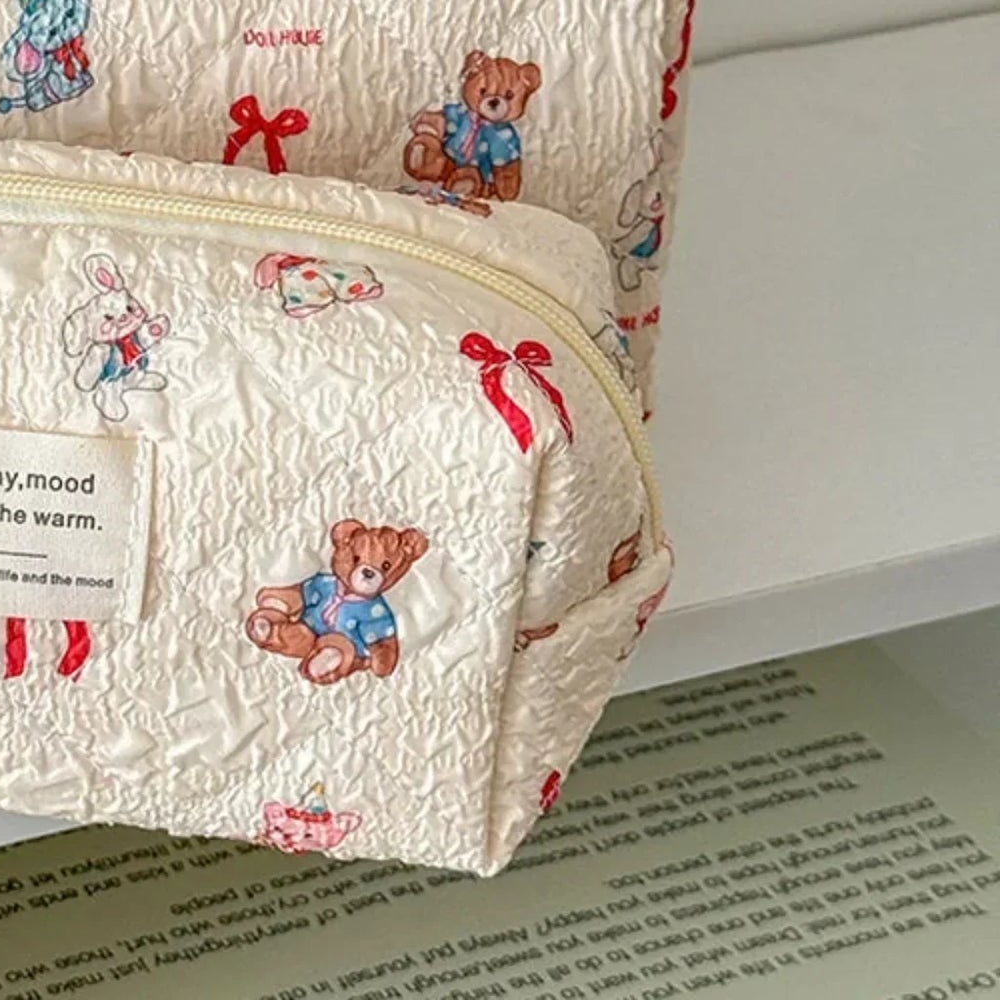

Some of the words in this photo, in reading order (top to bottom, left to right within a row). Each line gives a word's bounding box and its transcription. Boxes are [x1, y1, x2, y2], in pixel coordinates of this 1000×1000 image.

[33, 511, 103, 532] warm.
[22, 571, 48, 585] and
[50, 573, 73, 587] the
[75, 576, 115, 589] mood
[564, 795, 610, 813] they
[766, 833, 804, 849] the
[929, 834, 976, 852] May
[187, 850, 233, 869] with
[716, 841, 767, 863] other
[891, 842, 931, 862] you
[953, 849, 993, 869] you
[125, 865, 168, 884] kiss
[169, 860, 185, 873] a
[727, 861, 783, 882] hope
[843, 856, 896, 875] have
[905, 862, 959, 881] have
[28, 872, 58, 888] let
[82, 876, 122, 897] and
[312, 879, 356, 900] who
[389, 881, 425, 898] the
[702, 874, 730, 890] to
[769, 868, 843, 895] enough
[863, 874, 906, 893] only
[929, 881, 977, 899] hug
[27, 887, 79, 909] ends
[243, 882, 267, 900] of
[646, 881, 703, 904] make
[823, 886, 862, 904] one
[169, 887, 240, 916] people
[341, 891, 389, 916] best
[606, 894, 645, 915] you
[668, 886, 773, 921] happiness
[788, 897, 826, 913] life
[879, 891, 935, 913] them
[315, 908, 338, 927] of
[643, 913, 671, 929] to
[746, 906, 787, 928] and
[850, 906, 882, 921] for
[925, 902, 988, 924] There
[169, 920, 214, 939] who
[586, 921, 644, 944] make
[706, 917, 746, 936] one
[889, 917, 925, 935] are
[116, 931, 169, 954] hurt,
[457, 927, 529, 953] Always
[545, 933, 584, 955] you
[631, 927, 706, 956] chance
[731, 925, 804, 953] Dream
[797, 926, 890, 960] moments
[53, 946, 114, 970] those
[419, 941, 457, 965] put
[605, 948, 633, 963] to
[679, 946, 734, 969] what
[773, 952, 800, 967] in
[4, 963, 50, 984] who
[108, 956, 151, 981] just
[337, 953, 417, 991] yourself
[545, 964, 572, 983] all
[574, 955, 604, 972] do
[639, 957, 680, 979] you
[738, 958, 778, 977] life
[45, 971, 104, 996] make
[309, 980, 334, 994] in
[507, 972, 545, 989] the
[586, 971, 639, 996] want
[641, 981, 680, 998] you
[680, 969, 739, 992] when
[559, 985, 586, 998] to
